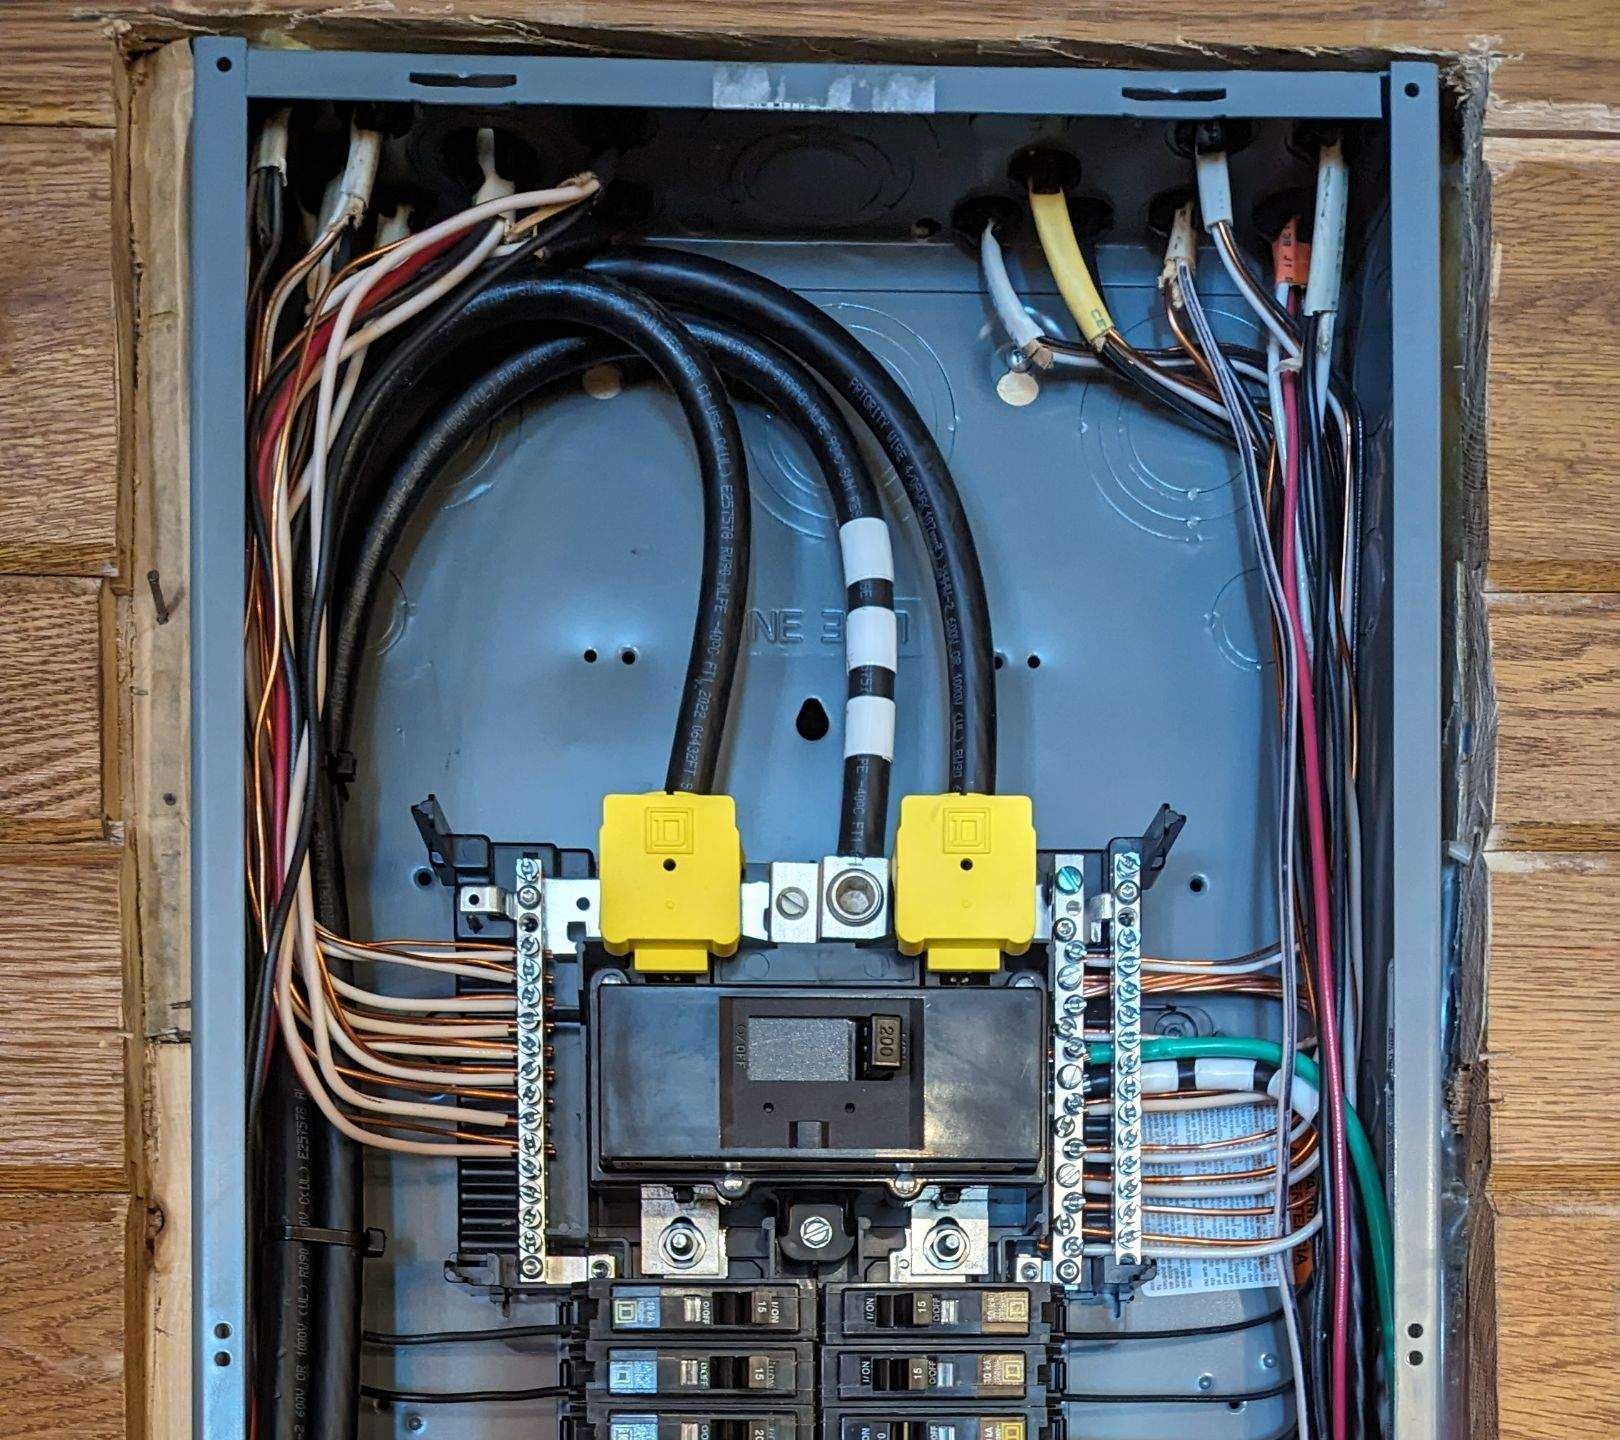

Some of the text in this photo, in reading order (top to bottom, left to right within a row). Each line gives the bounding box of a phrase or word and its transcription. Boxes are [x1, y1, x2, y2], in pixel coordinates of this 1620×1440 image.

[850, 376, 891, 429] PRIORITY
[719, 483, 735, 539] E257578
[692, 688, 712, 719] 2022
[879, 1024, 895, 1057] 200
[702, 1301, 710, 1325] O/OFF
[758, 1301, 766, 1313] 15
[772, 1301, 780, 1324] I/ON
[866, 1298, 874, 1320] I/ON
[918, 1300, 926, 1313] 15
[294, 1363, 307, 1381] OR
[755, 1368, 764, 1380] 15
[862, 1360, 871, 1384] I/ON
[914, 1366, 923, 1380] 15
[984, 1426, 993, 1437] kA
